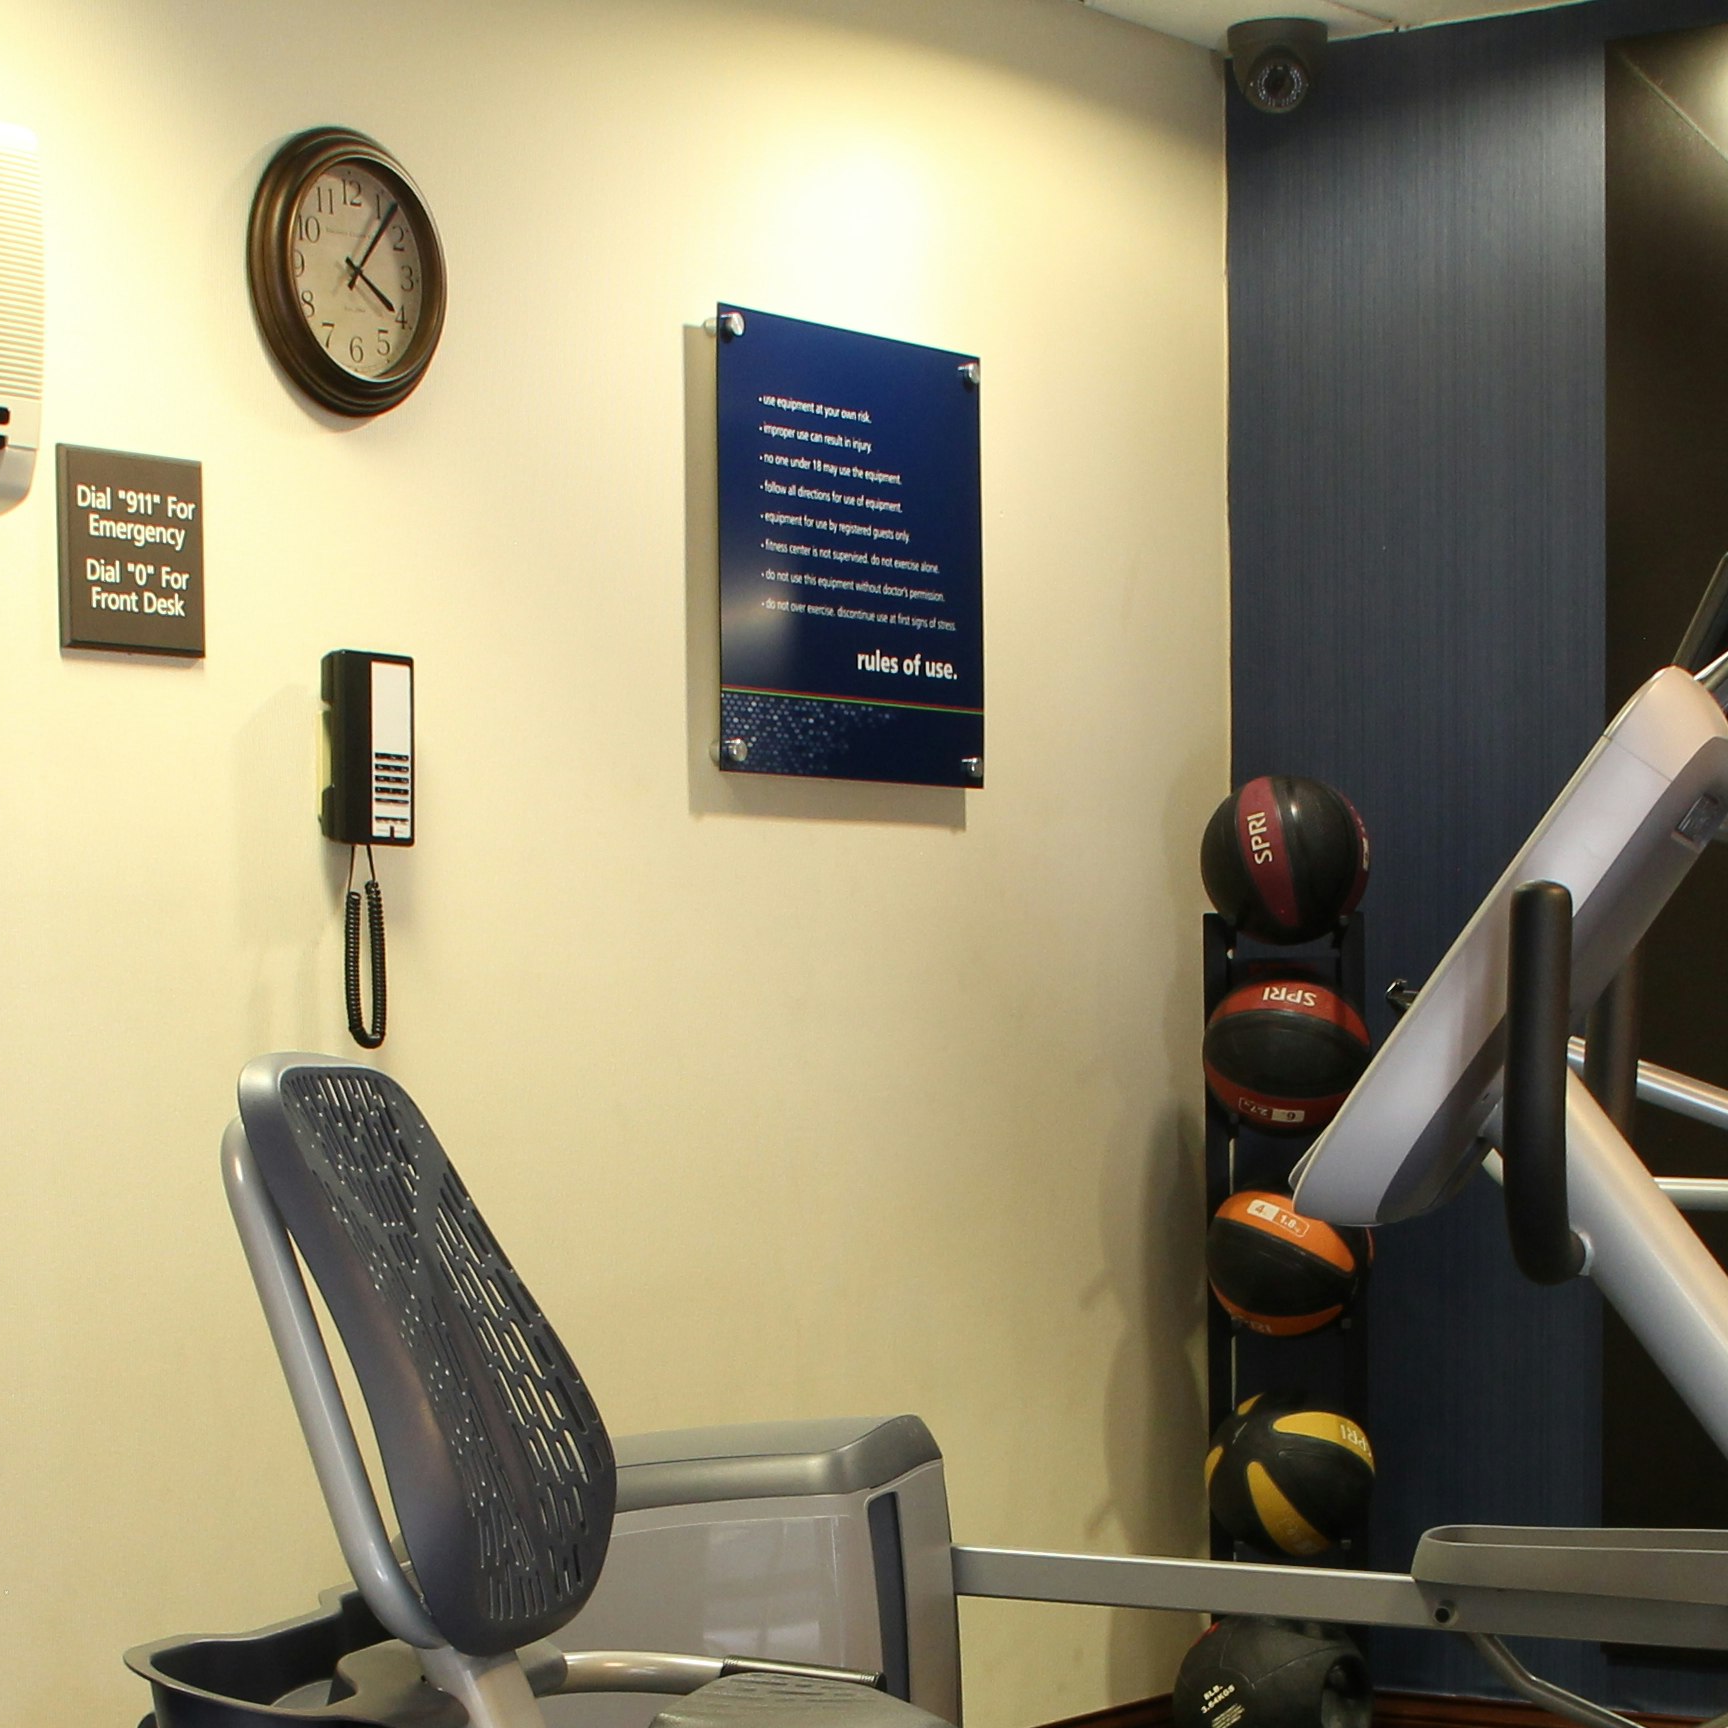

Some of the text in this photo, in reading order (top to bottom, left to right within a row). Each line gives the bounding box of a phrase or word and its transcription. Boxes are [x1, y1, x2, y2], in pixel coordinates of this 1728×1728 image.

[317, 187, 334, 214] 11
[342, 179, 362, 207] 12
[298, 215, 320, 243] 10
[392, 226, 404, 251] 2
[294, 249, 305, 277] 9
[401, 266, 414, 292] 3
[301, 290, 315, 318] 8
[395, 305, 408, 329] 4
[322, 322, 335, 348] 7
[377, 329, 390, 356] 5
[350, 336, 364, 363] 6
[763, 395, 872, 424] use equipment at your own risk.
[764, 421, 795, 438] improper
[797, 431, 809, 442] use
[810, 432, 823, 443] can
[824, 434, 843, 447] result
[764, 453, 773, 464] no
[775, 455, 788, 467] one
[791, 456, 811, 470] under
[813, 459, 821, 471] 18
[823, 463, 838, 477] may
[839, 465, 851, 477] use
[852, 466, 863, 478] the
[77, 484, 195, 520] Dial "911" For
[764, 479, 786, 495] follow
[788, 484, 796, 496] all
[798, 485, 830, 502] directions
[832, 490, 842, 502] for
[844, 495, 855, 506] use
[857, 495, 864, 507] of
[89, 513, 185, 551] Emergency
[765, 511, 802, 526] equipment
[804, 514, 814, 528] for
[816, 519, 827, 530] use
[829, 519, 838, 534] by
[839, 521, 871, 536] registered
[873, 528, 894, 541] guests
[765, 539, 788, 552] fitness
[790, 544, 811, 557] center
[820, 547, 831, 559] not
[871, 553, 880, 566] do
[881, 557, 893, 568] not
[894, 558, 920, 571] exercise
[86, 558, 120, 583] Dial
[161, 566, 189, 590] For
[766, 568, 775, 580] do
[777, 571, 789, 583] not
[791, 573, 802, 585] use
[804, 573, 816, 586] this
[819, 577, 854, 592] equipment
[856, 580, 882, 595] without
[92, 586, 185, 616] Front Desk
[766, 597, 775, 610] do
[777, 600, 789, 612] not
[791, 603, 806, 613] over
[837, 606, 875, 621] discontinue
[877, 612, 888, 623] use
[898, 612, 910, 626] first
[912, 615, 928, 630] signs
[929, 617, 936, 630] of
[857, 649, 958, 680] rules of use.
[1247, 812, 1272, 865] SPRI
[1262, 987, 1318, 1007] SPRI
[1340, 1424, 1372, 1458] PRI
